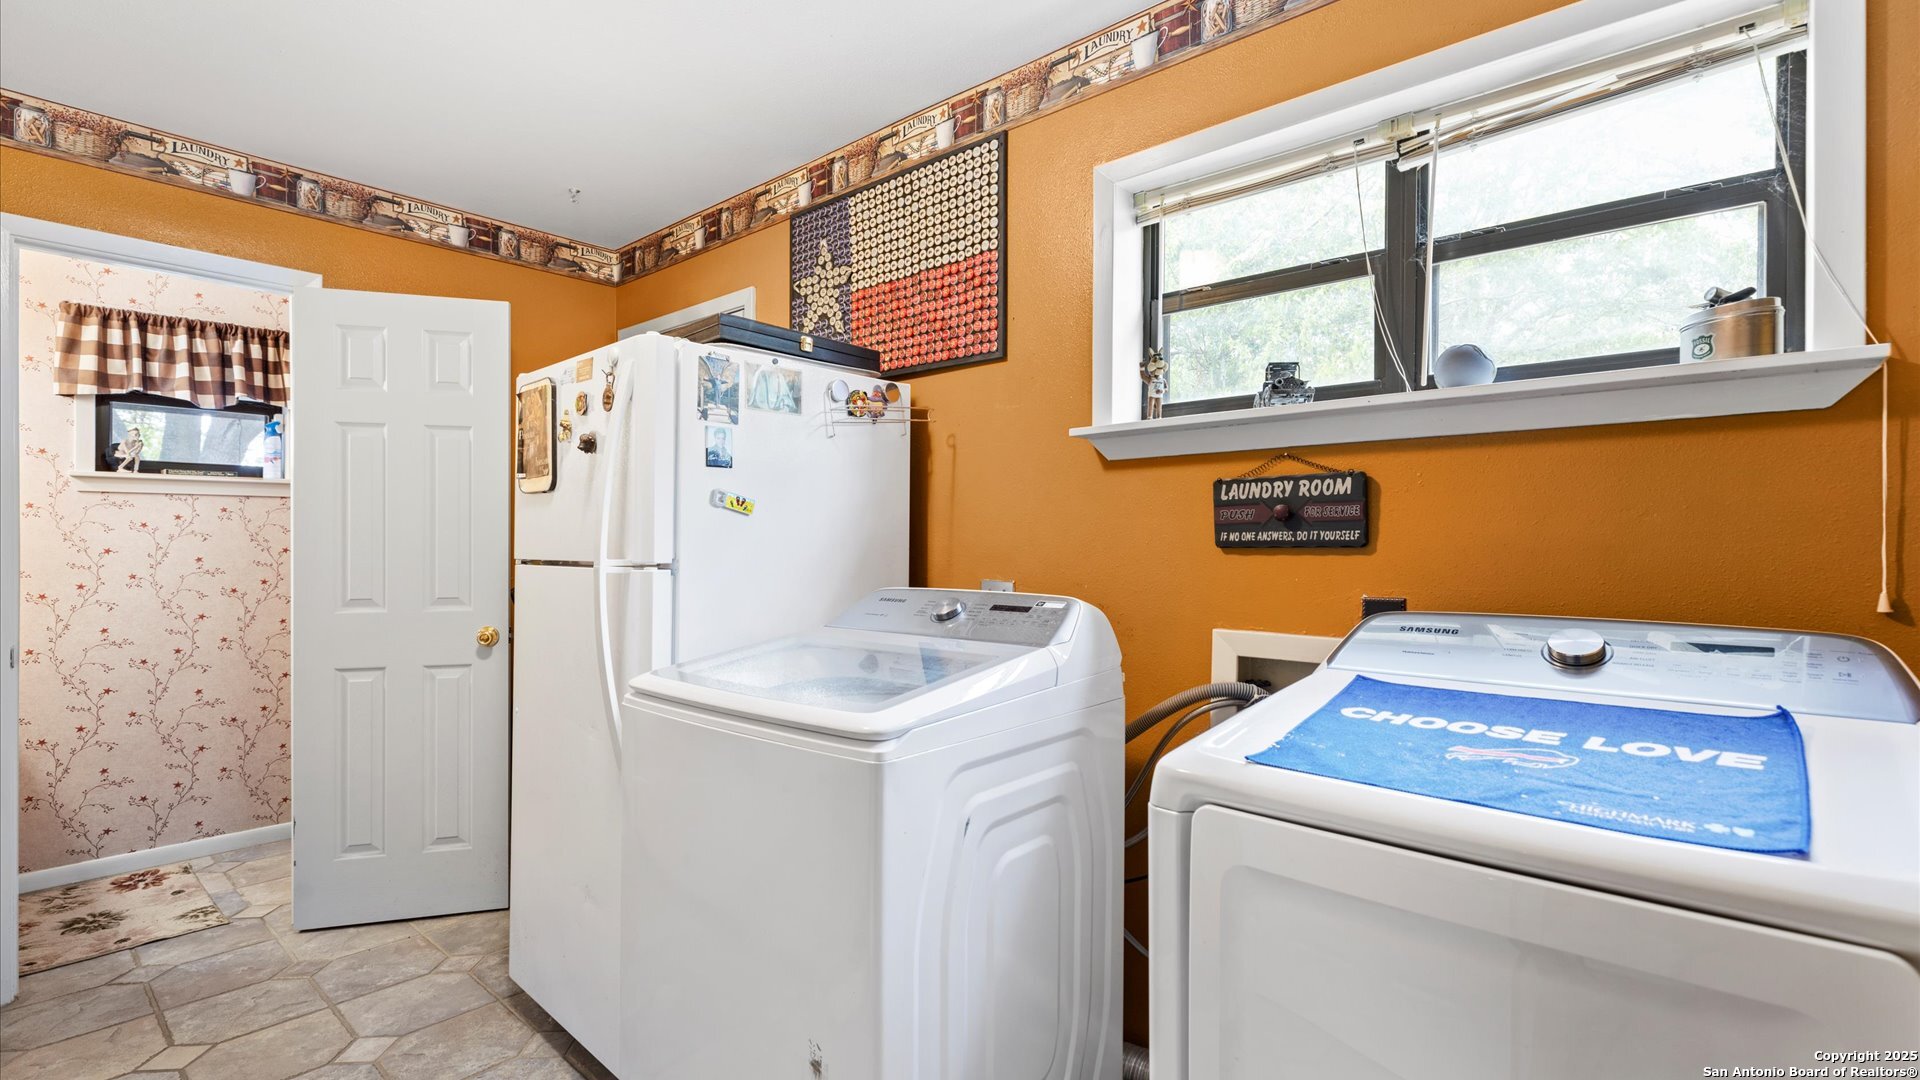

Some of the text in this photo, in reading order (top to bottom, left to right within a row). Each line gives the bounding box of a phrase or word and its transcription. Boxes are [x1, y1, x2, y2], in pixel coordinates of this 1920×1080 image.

[1083, 28, 1135, 62] LAUNDRY
[902, 114, 938, 138] LAUNDRY
[171, 141, 230, 168] LAUNDRY
[773, 176, 800, 195] LAUNDRY
[407, 202, 450, 224] LAUNDRY
[580, 246, 614, 263] LAUNDRY
[1220, 476, 1353, 501] LAUNDRY ROOM
[1219, 508, 1255, 521] PUSH
[1303, 504, 1361, 518] FOR SERVICE
[1220, 530, 1361, 542] IF NO ONE ANSWERS, DO IT YOURSELF
[1399, 625, 1459, 635] SAMSUNG
[1340, 706, 1768, 771] CHOOSE LOVE
